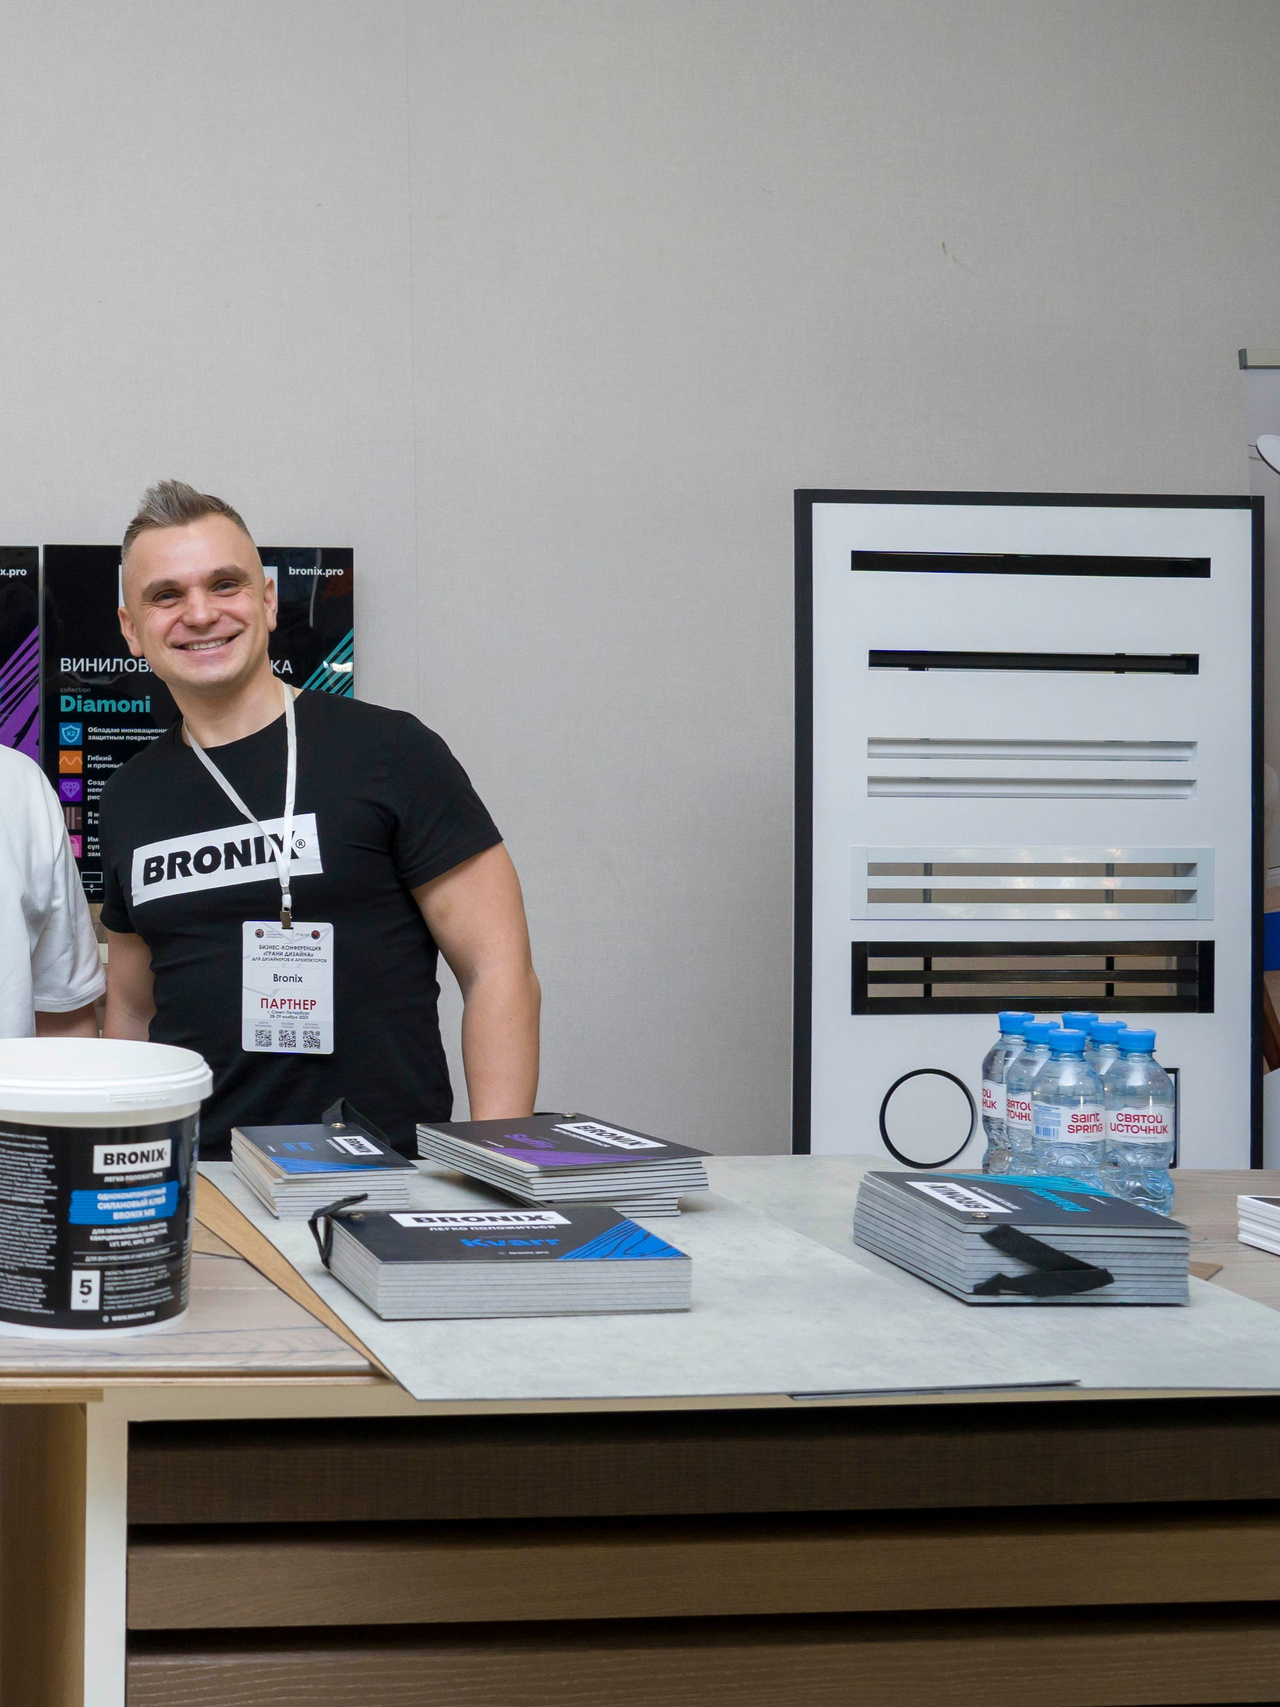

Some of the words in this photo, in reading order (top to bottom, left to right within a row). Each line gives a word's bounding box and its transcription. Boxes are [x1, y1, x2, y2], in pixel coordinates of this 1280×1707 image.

[288, 566, 344, 578] bronix.pro
[60, 658, 153, 673] ВИНИЛОВ
[60, 695, 151, 713] Diamoni
[273, 974, 303, 983] Bronix
[260, 998, 317, 1010] ПАРТНЕР
[1110, 1122, 1168, 1134] ИСТОЧНИК
[460, 1239, 560, 1247] Kvarr
[79, 1279, 92, 1295] 5
